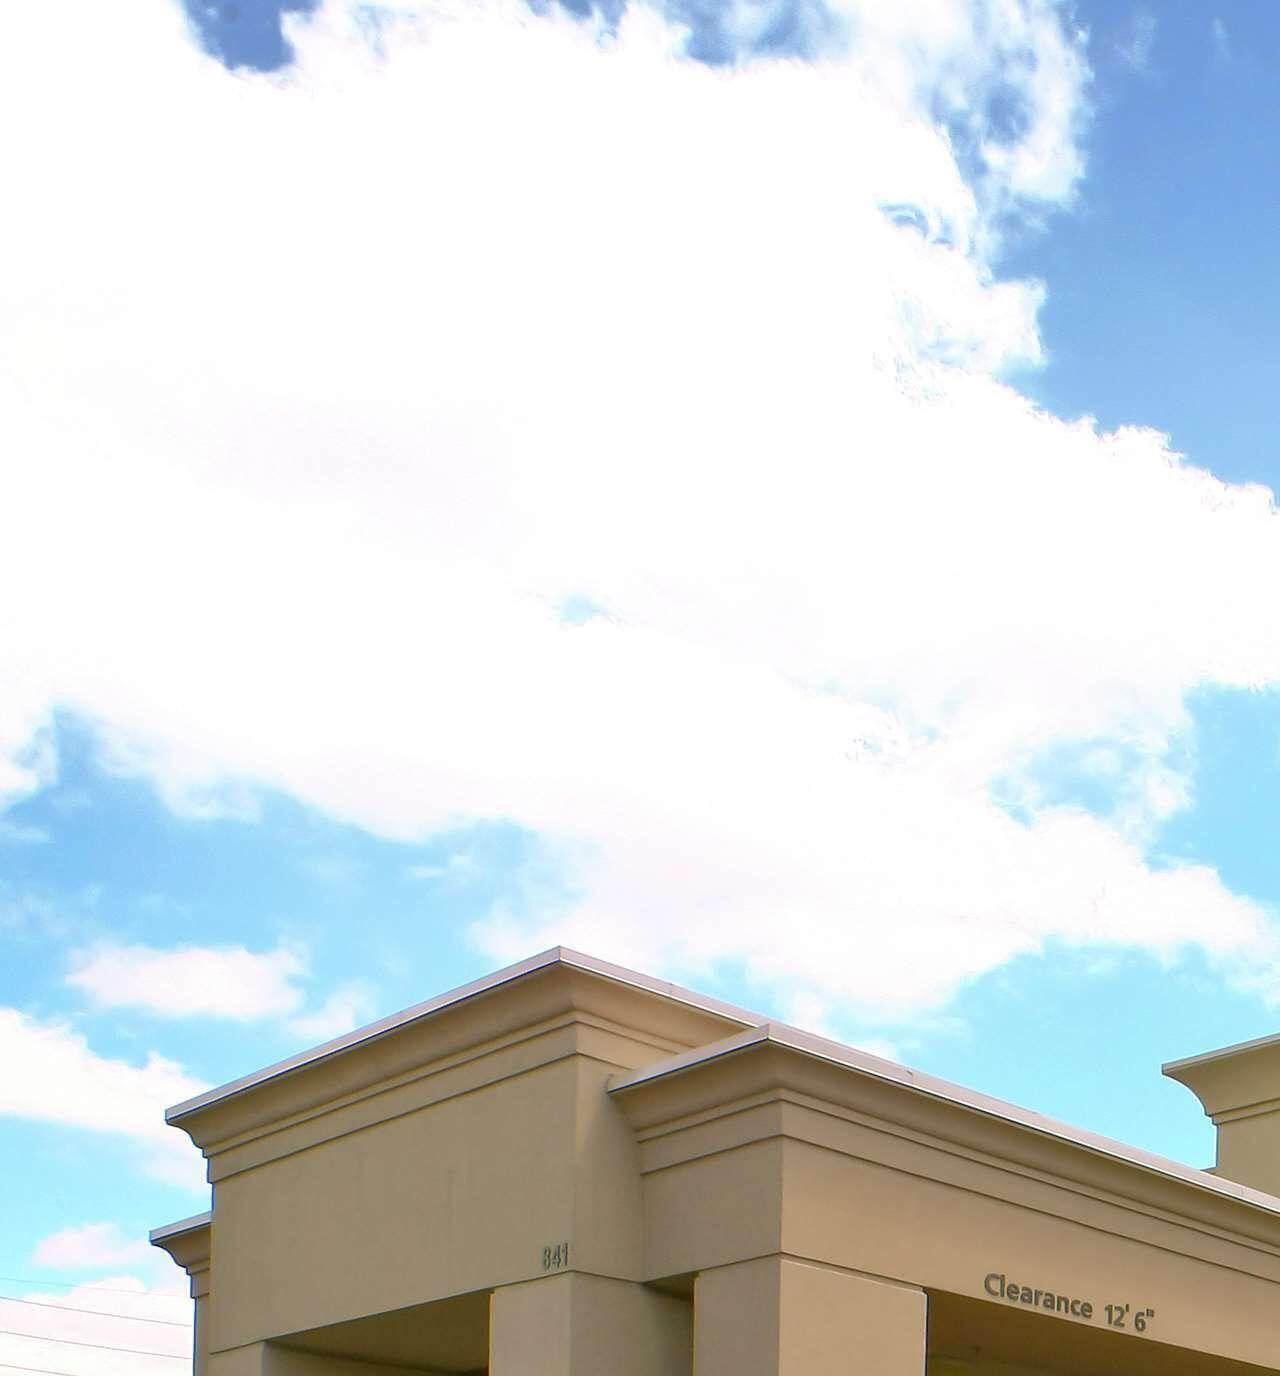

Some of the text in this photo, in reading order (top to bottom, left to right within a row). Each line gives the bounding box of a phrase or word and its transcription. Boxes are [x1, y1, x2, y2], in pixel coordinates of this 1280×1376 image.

[543, 1242, 568, 1270] 841
[984, 1273, 1154, 1332] Clearance 12' 6"
